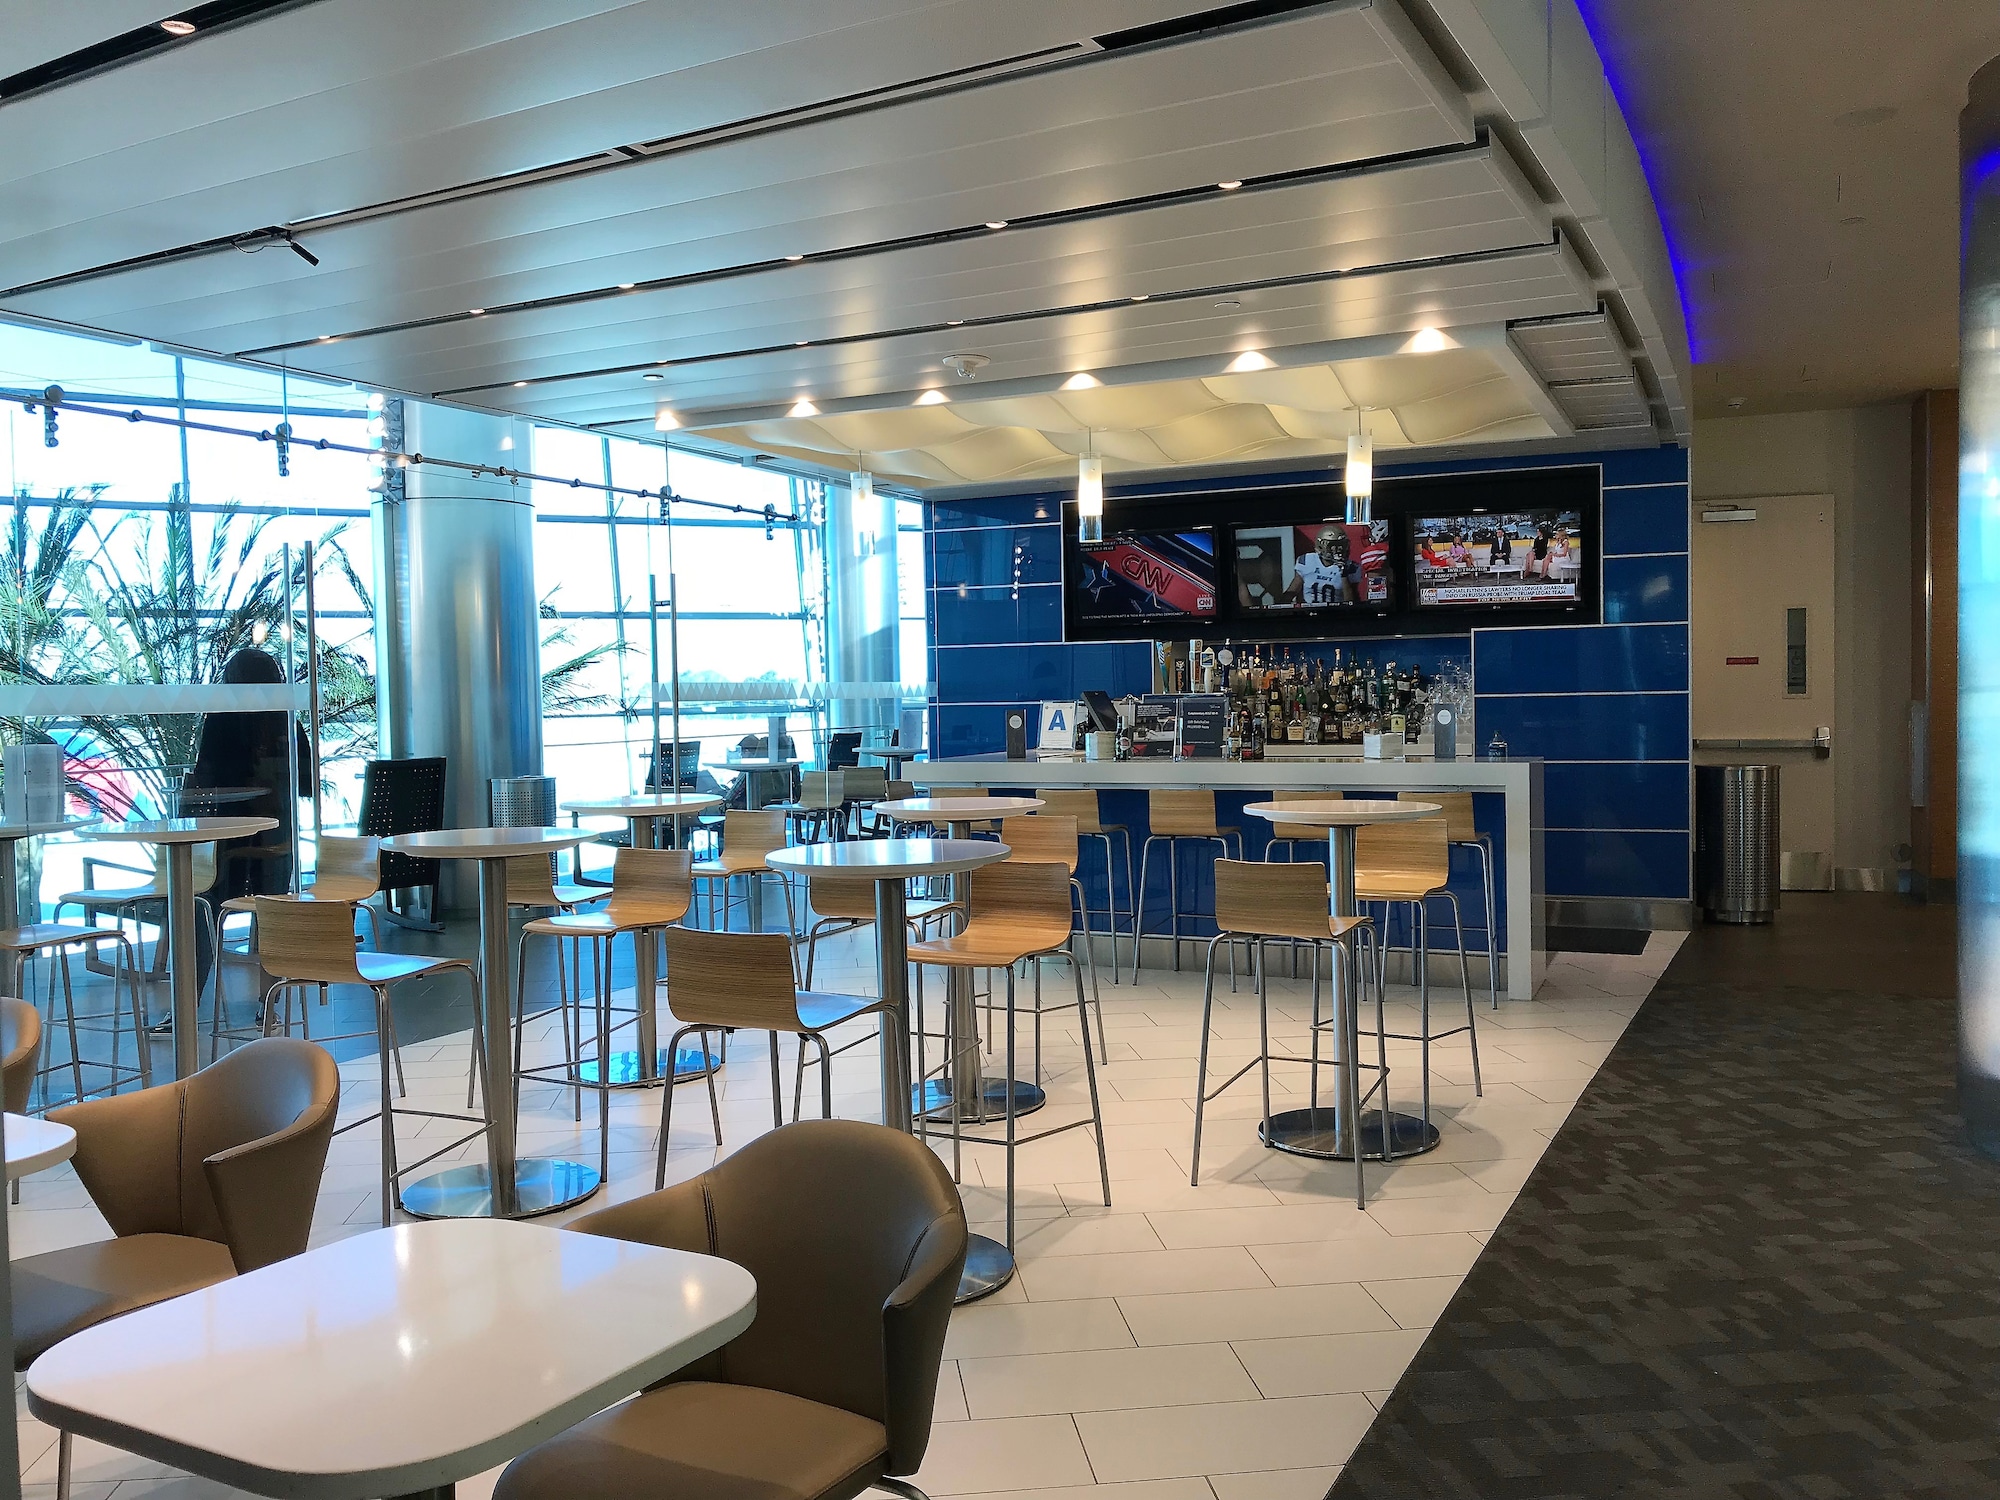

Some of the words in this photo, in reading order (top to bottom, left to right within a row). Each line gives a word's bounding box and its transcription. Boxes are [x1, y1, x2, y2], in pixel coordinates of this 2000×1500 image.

[1121, 553, 1173, 595] CNN
[1310, 582, 1335, 602] 10
[1048, 709, 1066, 731] A
